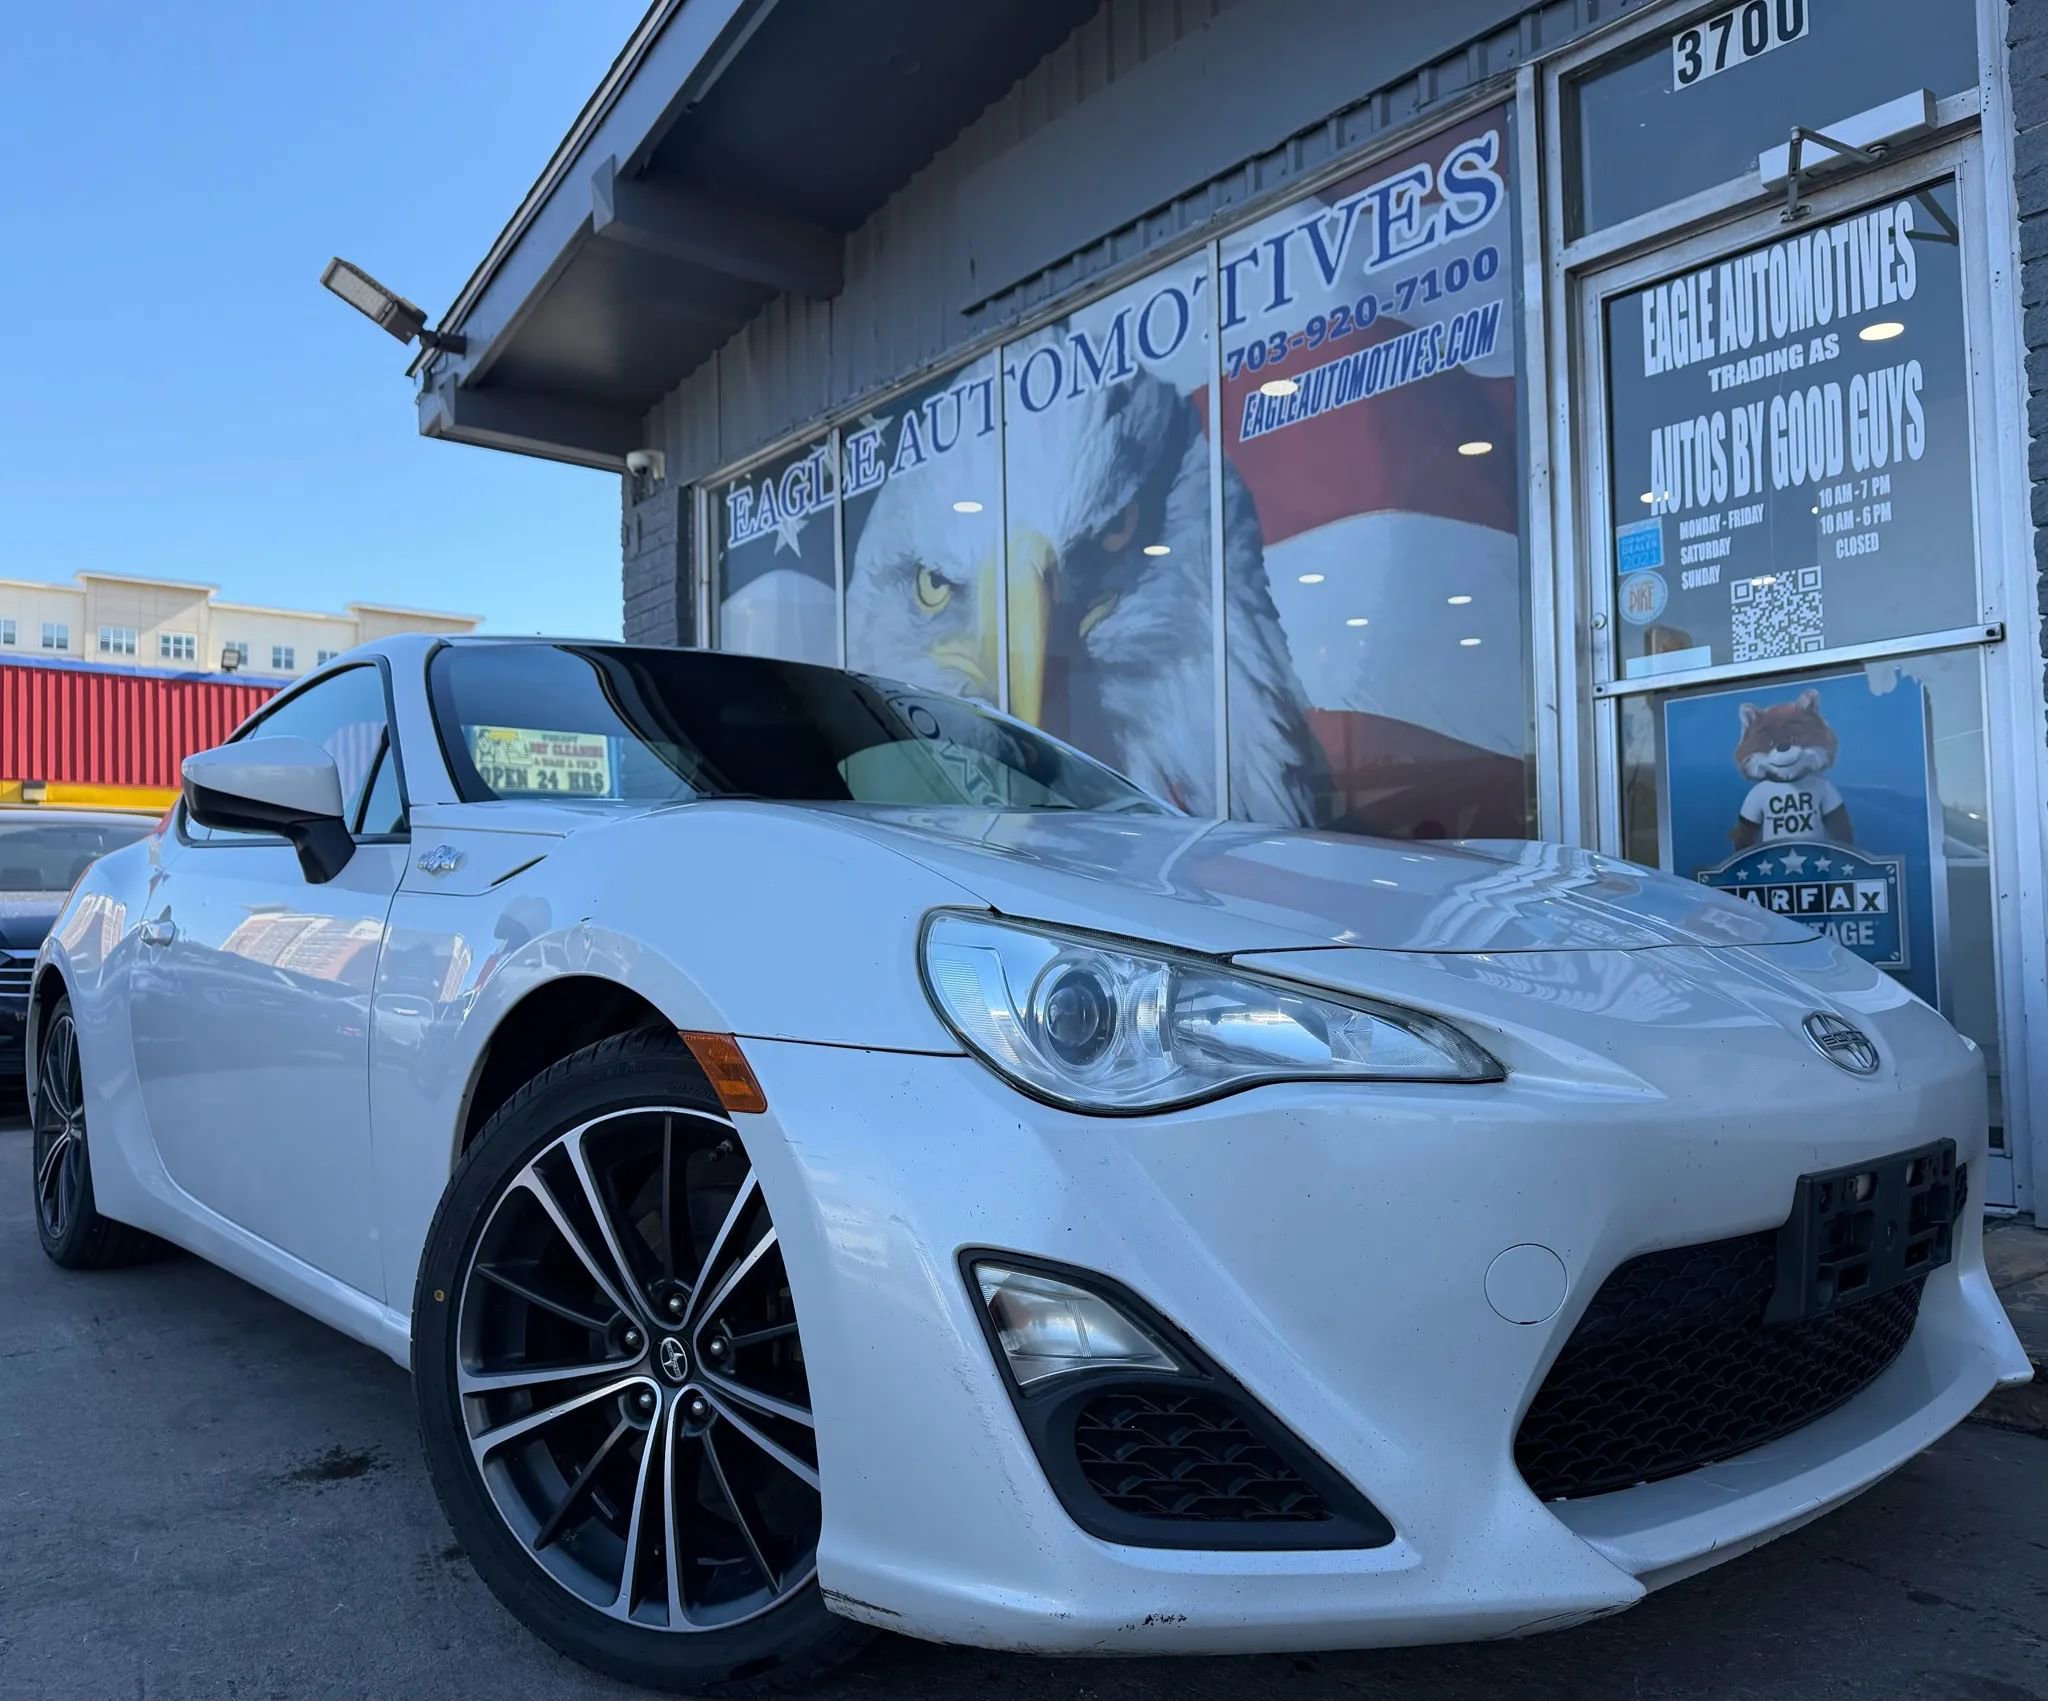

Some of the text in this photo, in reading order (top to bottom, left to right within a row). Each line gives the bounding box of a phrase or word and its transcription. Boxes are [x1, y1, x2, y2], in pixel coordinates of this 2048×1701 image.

[1677, 0, 1804, 85] 3700
[1642, 200, 1917, 377] EAGLE AUTOMOTIVES
[1226, 247, 1499, 381] 703-920-7100
[727, 130, 1504, 550] EAGLE AUTOMOTIVES
[1240, 300, 1503, 442] EAGLEAUTOMOTIVES.COM
[1708, 333, 1841, 391] TRADING AS
[1650, 360, 1926, 516] AUTOS BY GOOD GUYS
[1818, 488, 1833, 508] 10
[1834, 483, 1853, 506] AM
[1860, 479, 1868, 499] 7
[1871, 474, 1891, 497] PM
[1679, 512, 1721, 541] MONDAY
[1728, 504, 1764, 530] FRIDAY
[1820, 514, 1834, 535] 10
[1836, 510, 1854, 532] AM
[1862, 506, 1871, 526] 6
[1873, 501, 1892, 524] PM
[1680, 536, 1732, 566] SATURDAY
[1836, 532, 1880, 560] CLOSED
[1681, 564, 1721, 591] SUNDAY
[480, 766, 604, 792] OPEN 24 HRS
[1769, 792, 1813, 814] CAR
[1773, 812, 1814, 835] FOX
[1746, 886, 1882, 911] ARFAX
